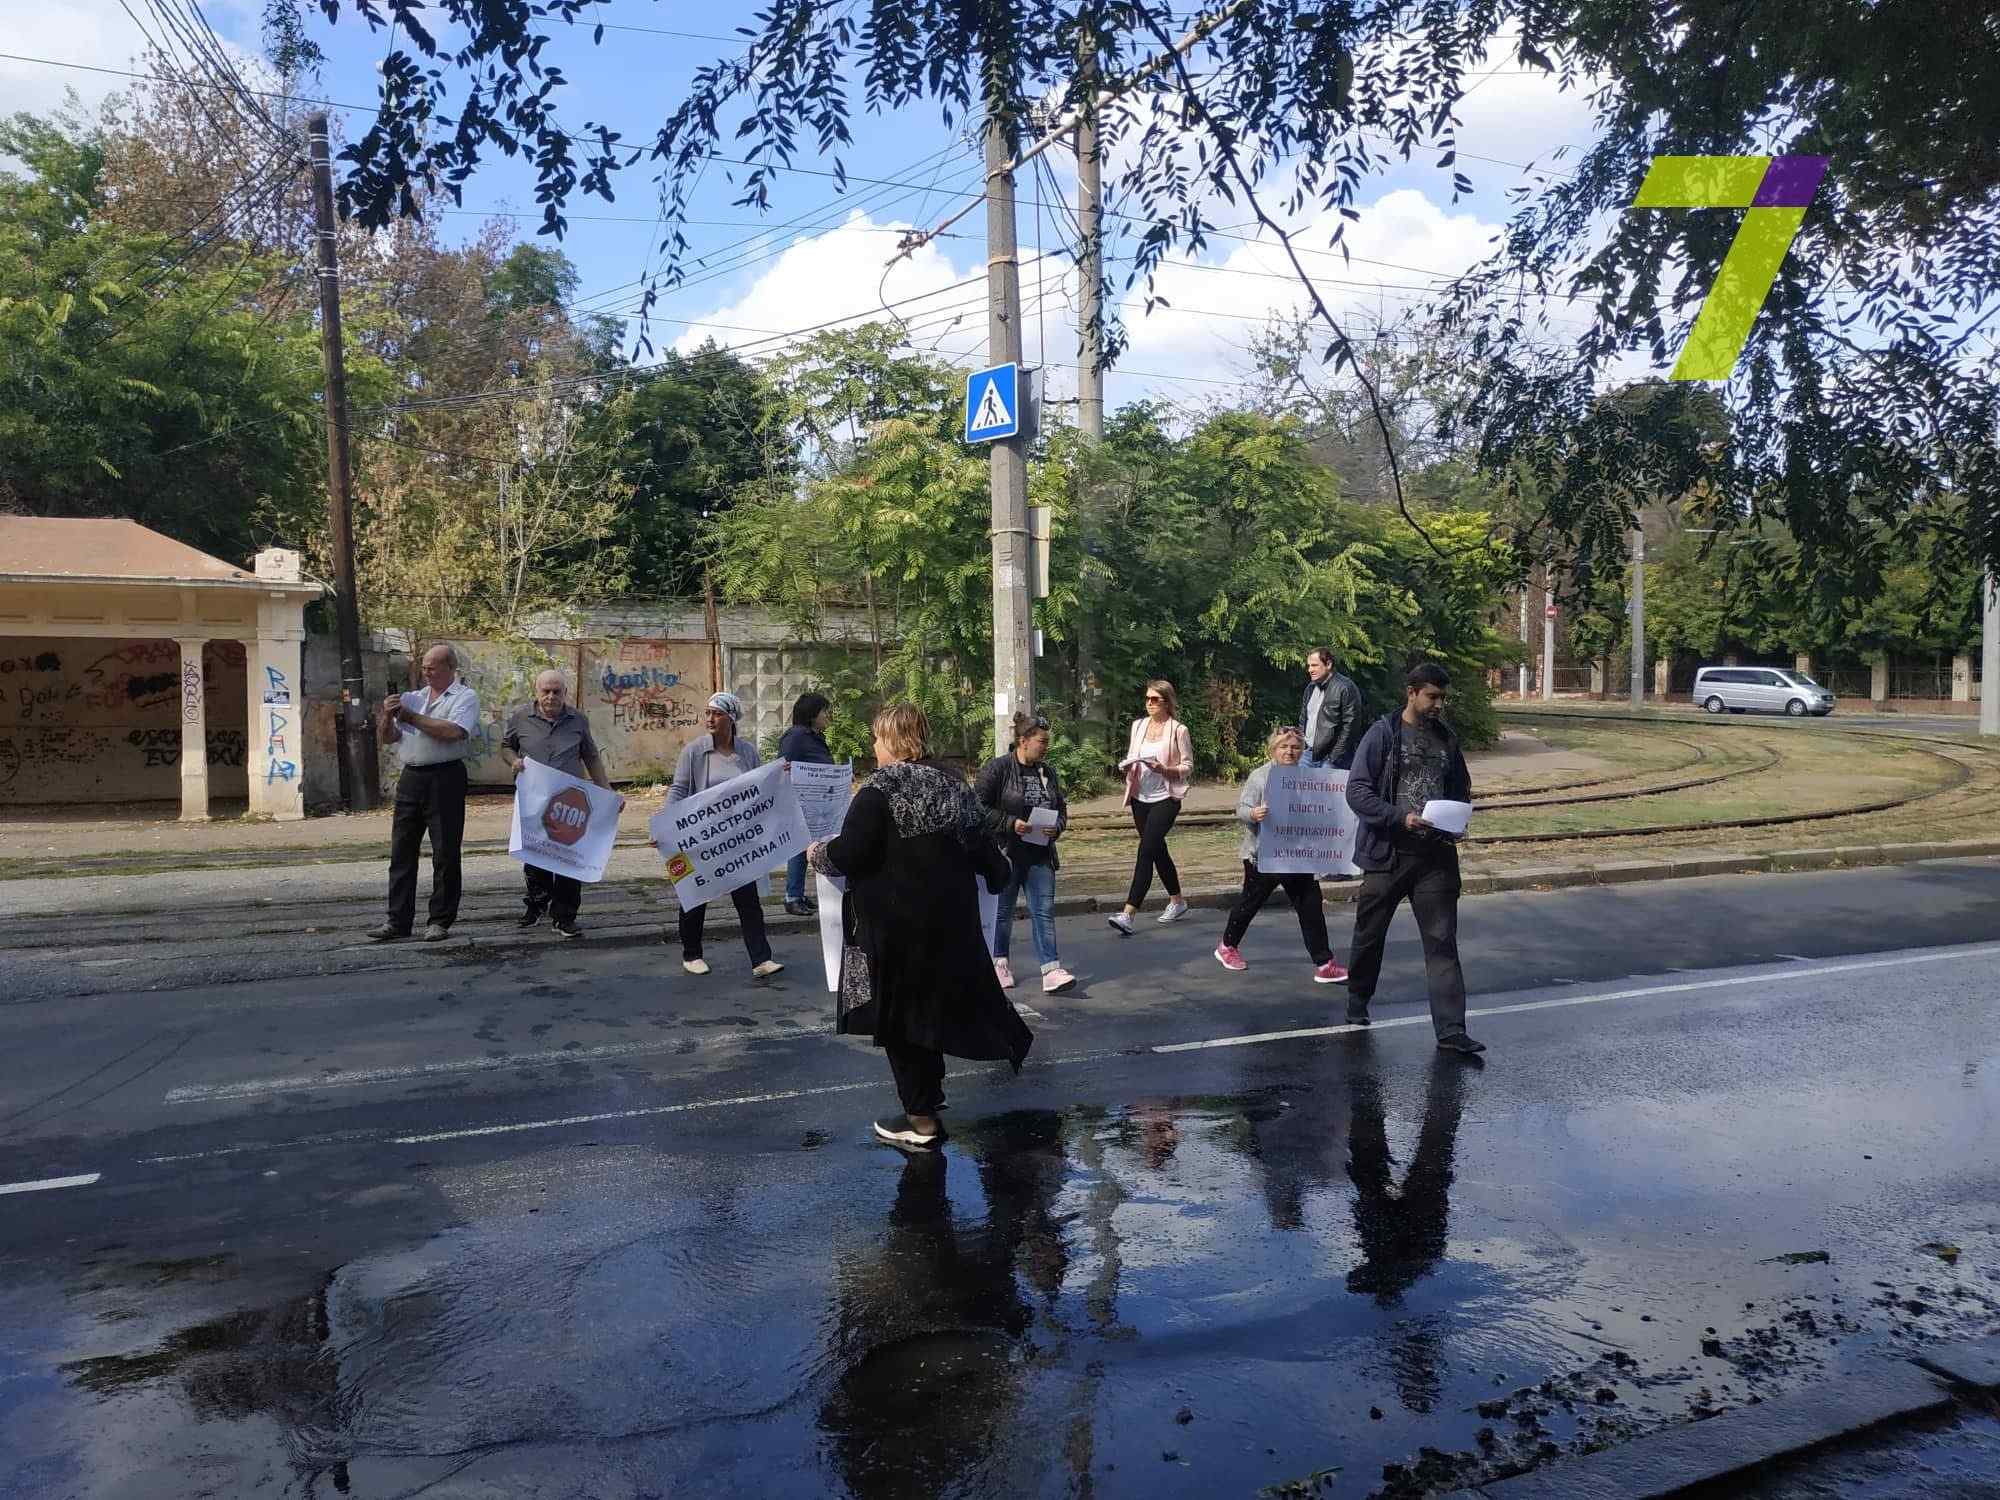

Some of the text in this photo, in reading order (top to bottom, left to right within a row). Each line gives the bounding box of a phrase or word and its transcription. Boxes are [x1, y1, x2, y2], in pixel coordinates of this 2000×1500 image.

[551, 802, 587, 828] STOP
[675, 784, 760, 831] МОРАТОРИЙ
[677, 796, 775, 852] НА ЗАСТРОЙКУ
[694, 875, 710, 887] Б.
[714, 840, 777, 879] ФОНТАНА
[700, 823, 764, 862] СКЛОНОВ
